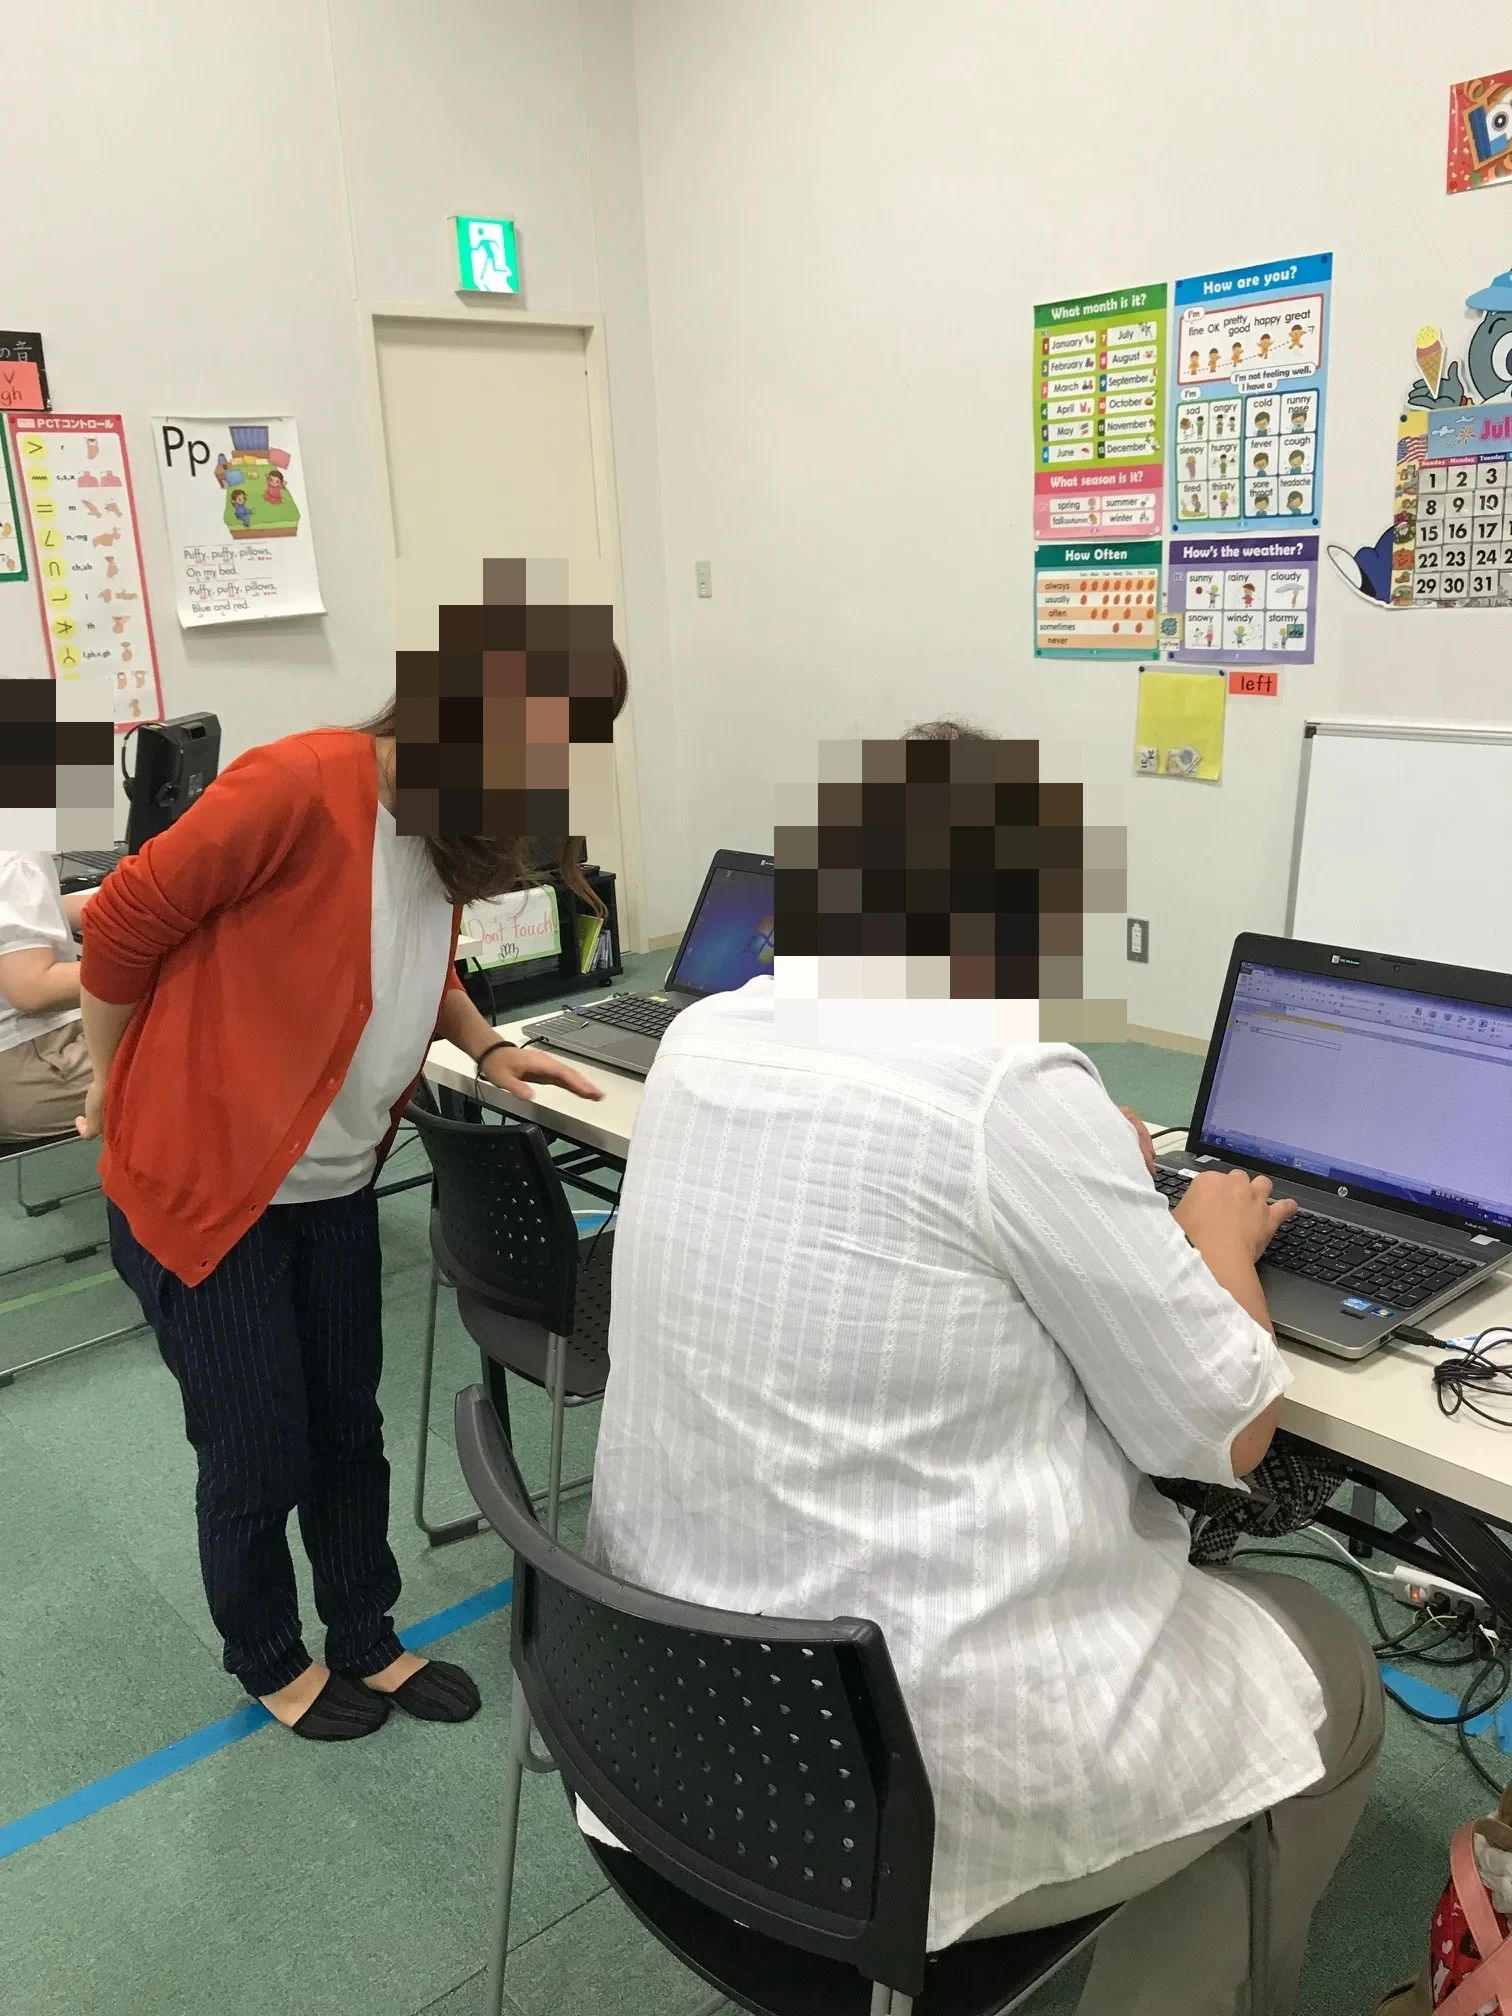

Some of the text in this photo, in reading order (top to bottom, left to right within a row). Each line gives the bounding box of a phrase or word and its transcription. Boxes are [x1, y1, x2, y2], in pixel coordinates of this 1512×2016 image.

[1203, 265, 1298, 295] How are you?
[1050, 293, 1147, 320] What month is it?
[1187, 309, 1200, 319] I'm
[1254, 309, 1311, 328] happy great
[1223, 314, 1248, 328] pretty
[1117, 330, 1134, 341] July
[1188, 323, 1220, 337] fine OK
[1228, 323, 1251, 337] good
[1051, 337, 1084, 351] January
[1111, 351, 1141, 365] August
[1050, 360, 1084, 372] February
[1234, 365, 1312, 383] I'm not feeling well.
[1108, 373, 1149, 388] September
[1241, 383, 1245, 391] I
[1246, 382, 1265, 391] have
[1053, 382, 1080, 393] March
[1184, 389, 1197, 398] I'm
[1108, 397, 1143, 409] October
[1253, 397, 1273, 408] cold
[1286, 395, 1312, 405] runny
[1056, 403, 1075, 415] April
[1186, 406, 1201, 416] sad
[1213, 402, 1238, 414] angry
[37, 418, 114, 429] PCTコントロール
[1107, 420, 1147, 431] November
[1479, 416, 1512, 442] Jul
[1057, 427, 1074, 437] May
[1210, 442, 1238, 453] hungry
[1250, 439, 1273, 449] fever
[1283, 436, 1311, 447] cough
[162, 425, 211, 478] Pp
[1056, 448, 1074, 458] June
[1107, 442, 1147, 454] December
[1179, 445, 1205, 456] sleepy
[1421, 459, 1446, 468] Sunday
[1479, 453, 1505, 462] Tuesday
[1050, 470, 1144, 488] What season is it?
[1252, 480, 1270, 488] sore
[1280, 478, 1311, 488] headache
[1429, 468, 1498, 489] 1 2 3
[1183, 483, 1202, 493] tired
[1211, 481, 1236, 492] thirsty
[1057, 500, 1081, 511] spring
[1105, 498, 1138, 507] summer
[1425, 494, 1499, 516] 8 9 10
[1110, 513, 1133, 522] winter
[1420, 525, 1439, 542] 15
[1448, 523, 1468, 540] 16
[1478, 522, 1499, 539] 17
[1065, 548, 1128, 561] How Often
[1183, 542, 1304, 559] How's the weather?
[1418, 552, 1439, 569] 22
[1445, 551, 1466, 567] 23
[1476, 550, 1497, 566] 24
[186, 567, 202, 578] On
[203, 569, 217, 579] my
[1227, 573, 1250, 584] rainy
[1270, 571, 1302, 583] cloudy
[1189, 574, 1214, 585] sunny
[1416, 576, 1492, 594] 29 30 31
[1044, 582, 1071, 591] always
[191, 601, 212, 613] Blue
[213, 599, 231, 611] and
[1044, 596, 1071, 605] usually
[1048, 609, 1067, 618] often
[1187, 613, 1214, 625] snowy
[1227, 613, 1254, 625] windy
[1268, 613, 1300, 625] stormy
[1039, 623, 1076, 632] sometimes
[1047, 637, 1068, 645] never
[1240, 674, 1272, 693] left
